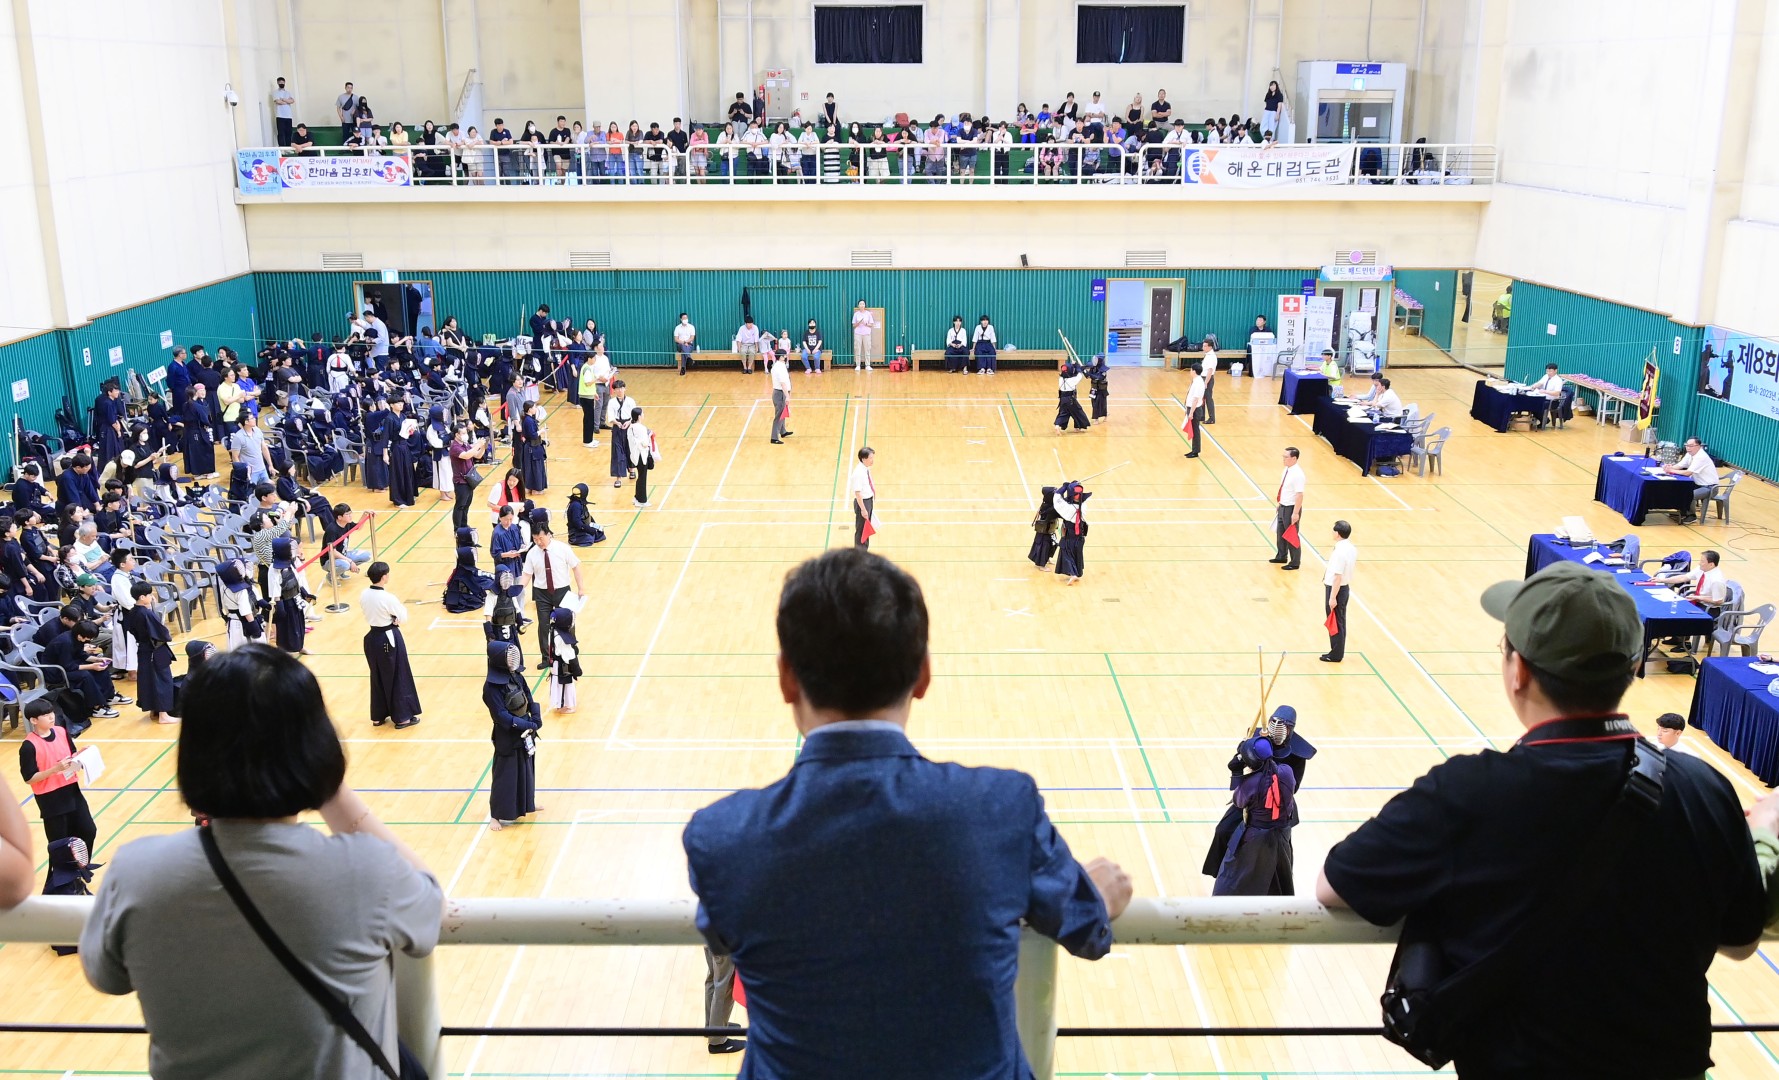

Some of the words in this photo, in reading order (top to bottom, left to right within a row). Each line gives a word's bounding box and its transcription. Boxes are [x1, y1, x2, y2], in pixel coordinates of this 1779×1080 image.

[308, 167, 338, 178] 한마음
[341, 166, 372, 178] 검우회
[1227, 158, 1341, 178] 해운대검도관
[1737, 342, 1779, 383] 제8회
[1759, 387, 1777, 402] 2023년
